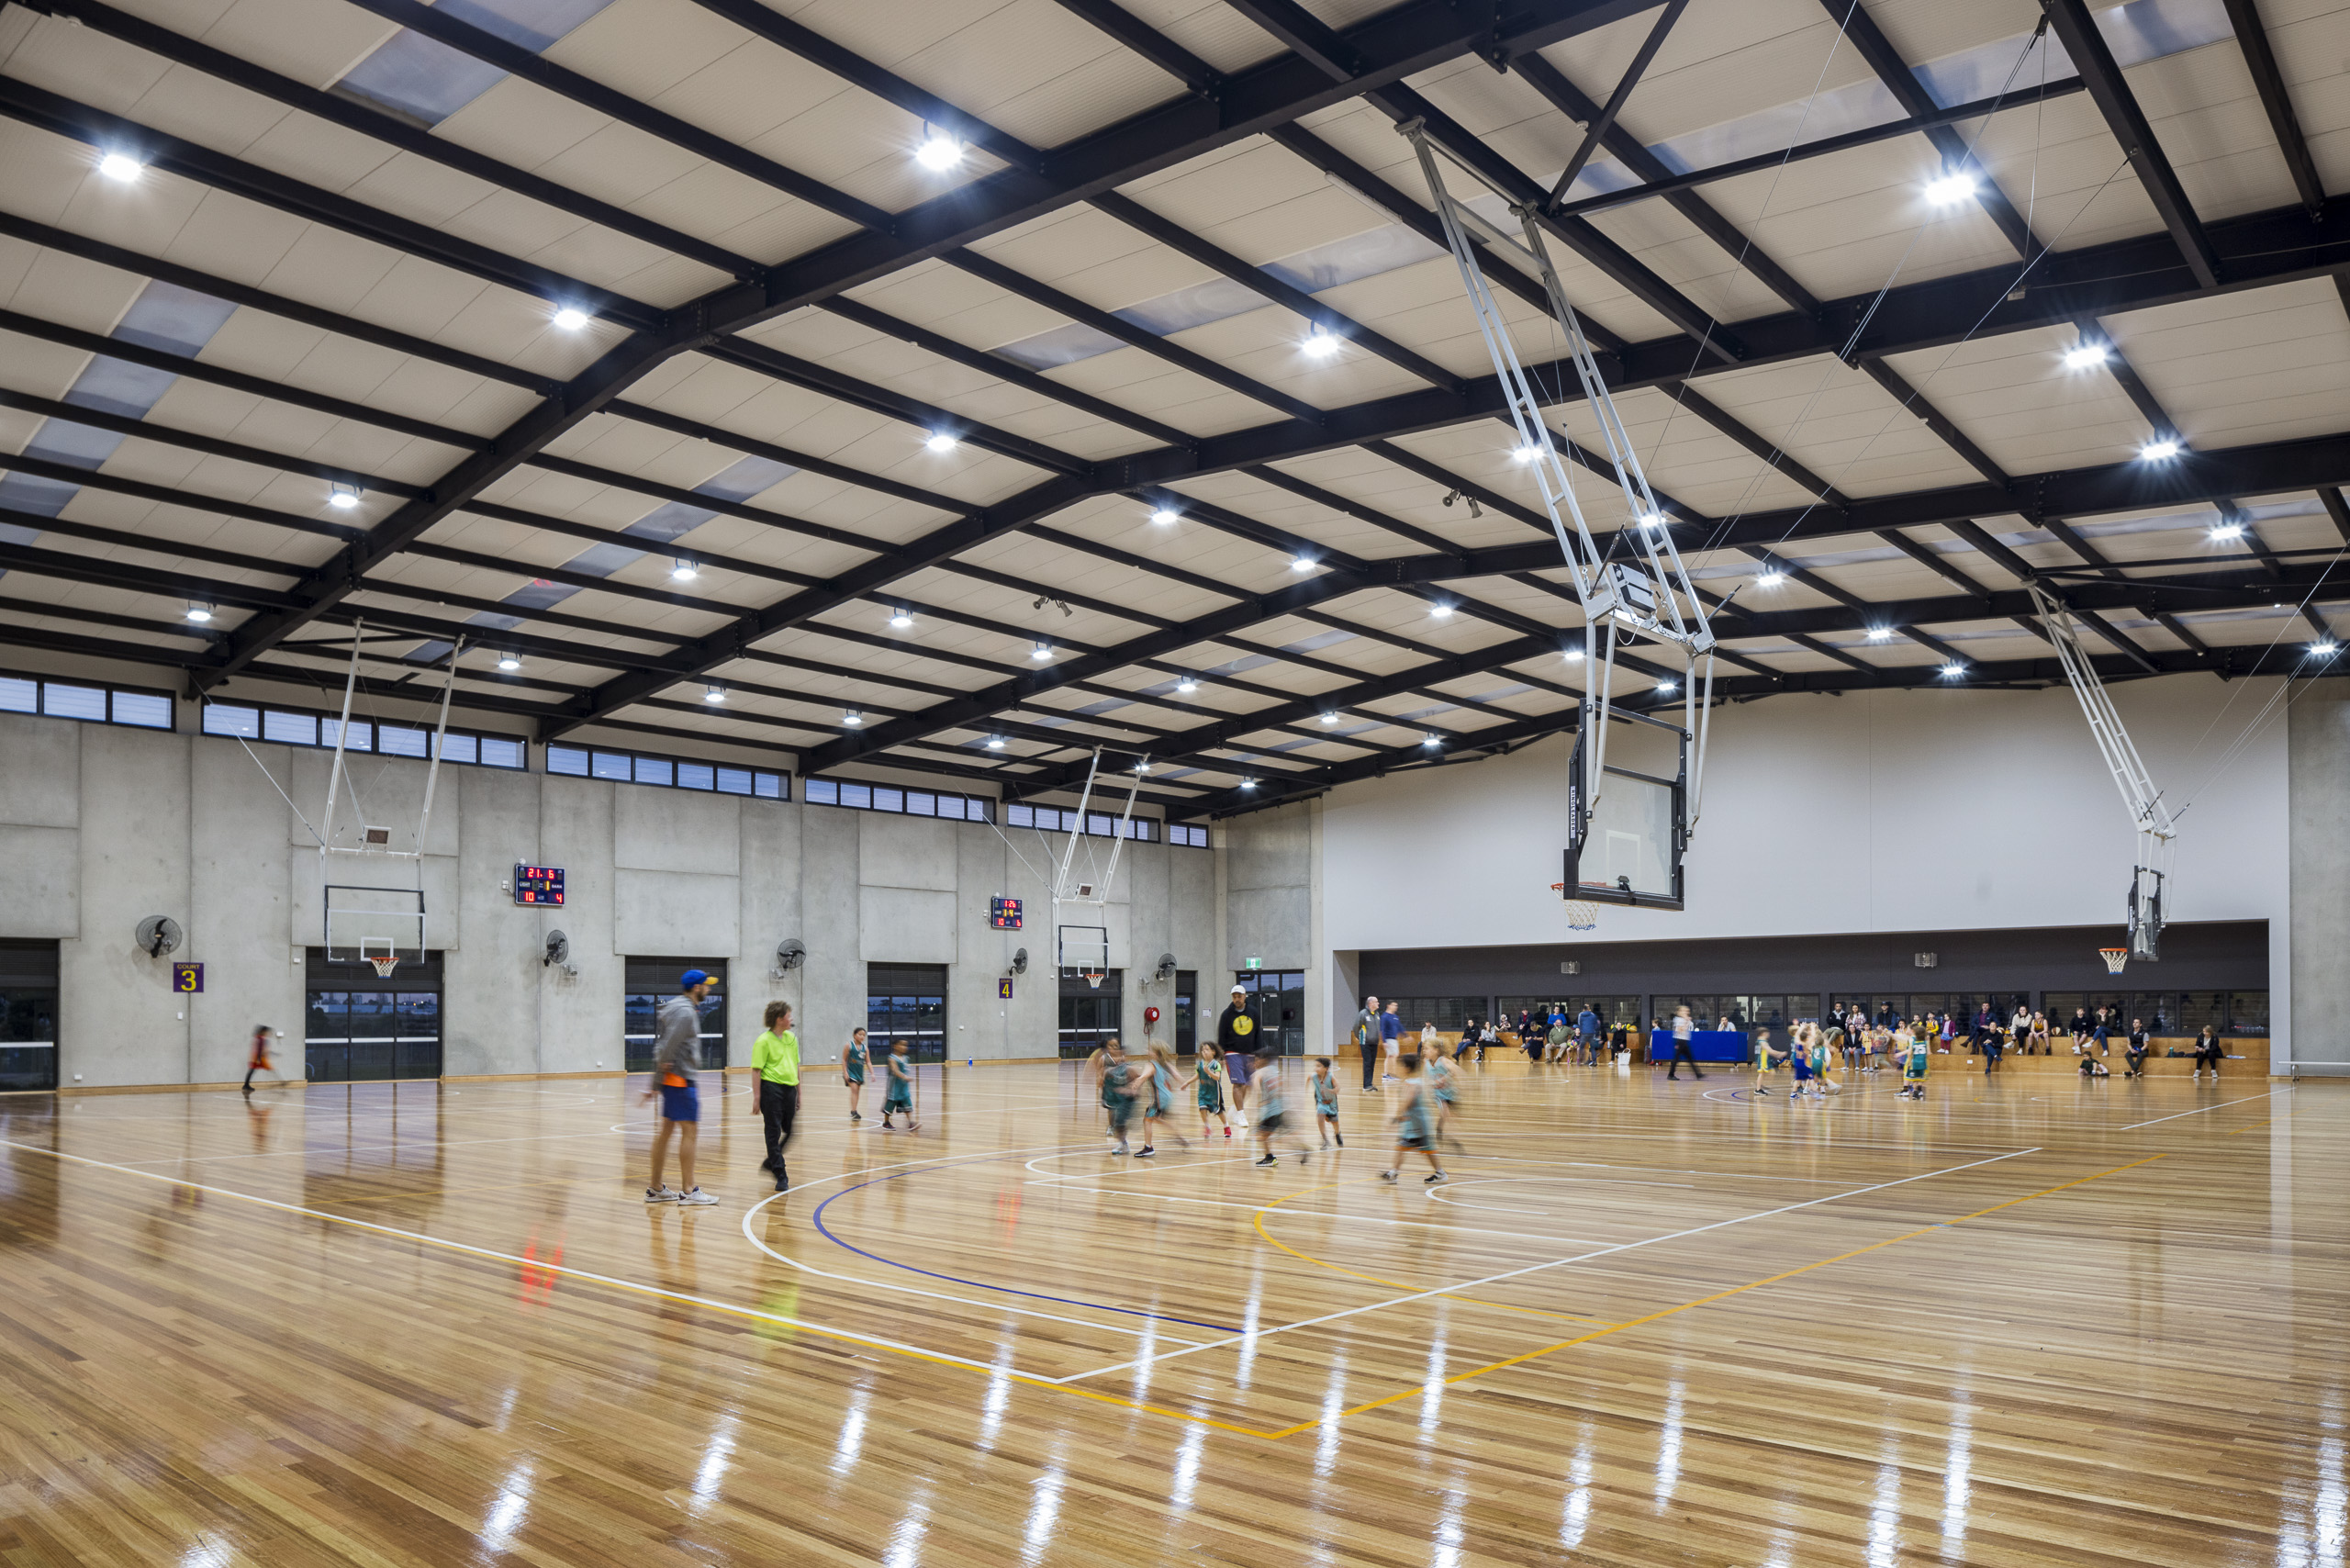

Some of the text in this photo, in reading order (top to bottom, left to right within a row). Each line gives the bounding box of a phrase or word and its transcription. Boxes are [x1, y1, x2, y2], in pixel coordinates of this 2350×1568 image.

[525, 890, 535, 902] 10
[555, 893, 563, 903] 4
[997, 917, 1005, 926] 10
[181, 970, 196, 991] 3
[1002, 983, 1010, 998] 4
